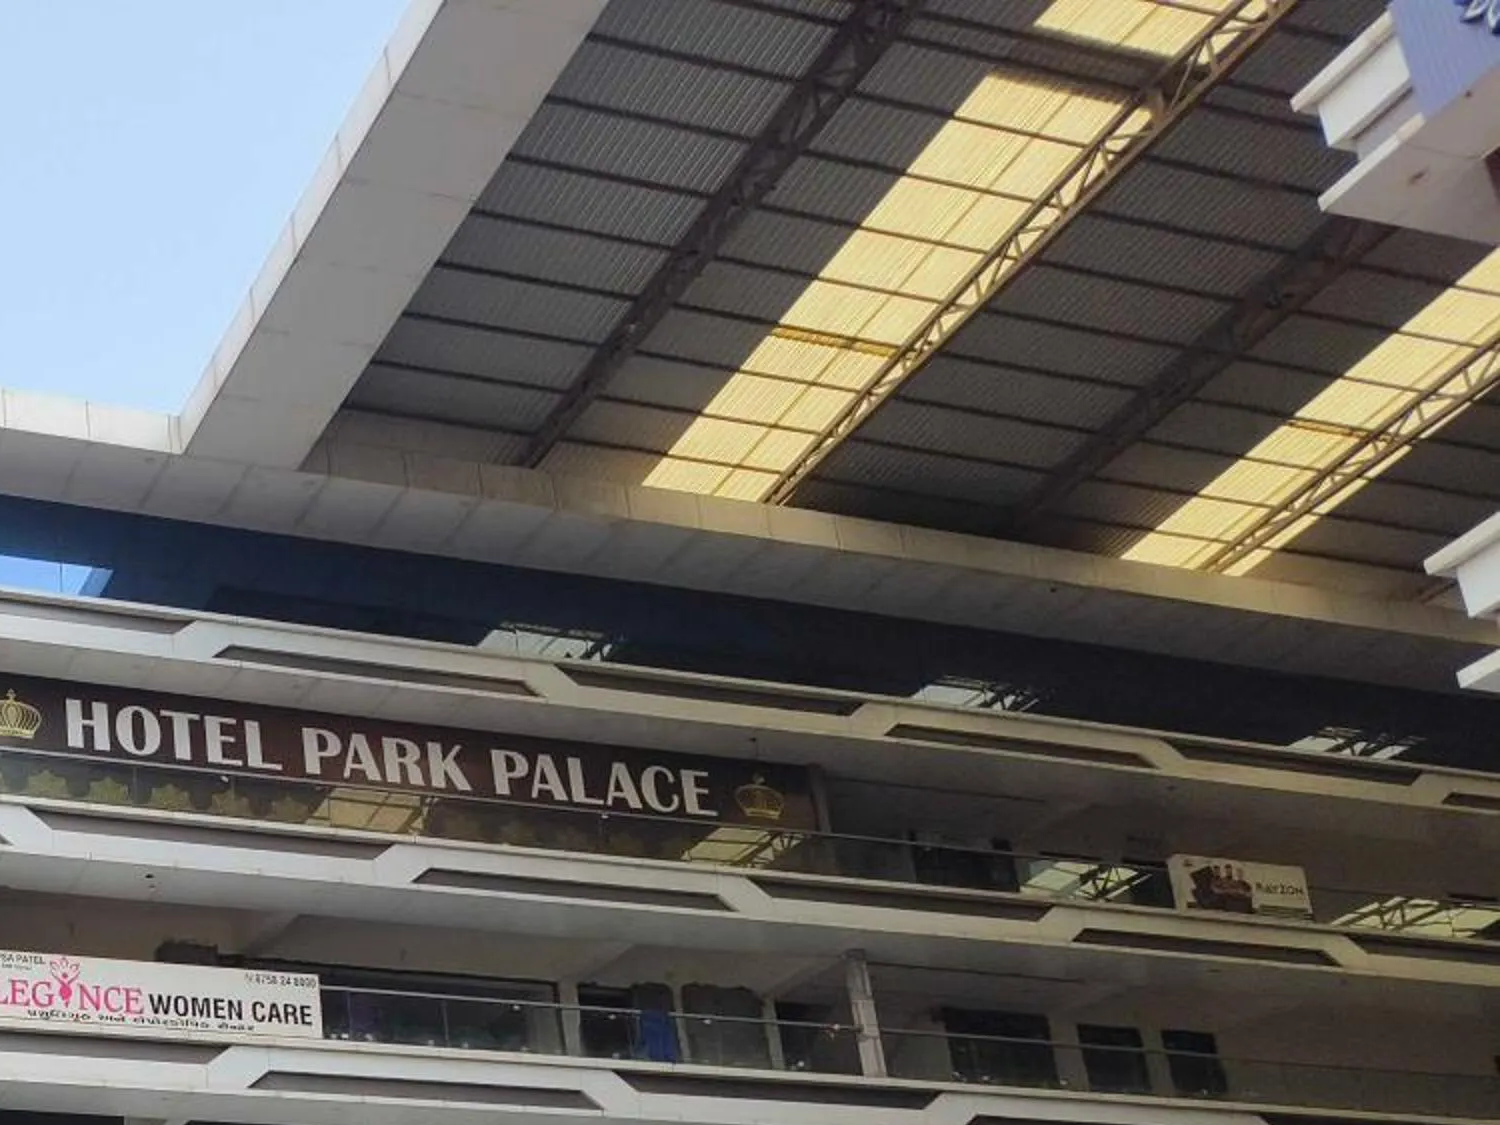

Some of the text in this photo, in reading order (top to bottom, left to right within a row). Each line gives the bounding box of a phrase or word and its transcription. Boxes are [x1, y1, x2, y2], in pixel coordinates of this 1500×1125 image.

[65, 697, 719, 818] HOTEL PARK PALACE
[16, 954, 46, 965] PATEL
[148, 994, 243, 1021] WOMEN
[252, 1001, 313, 1026] CARE
